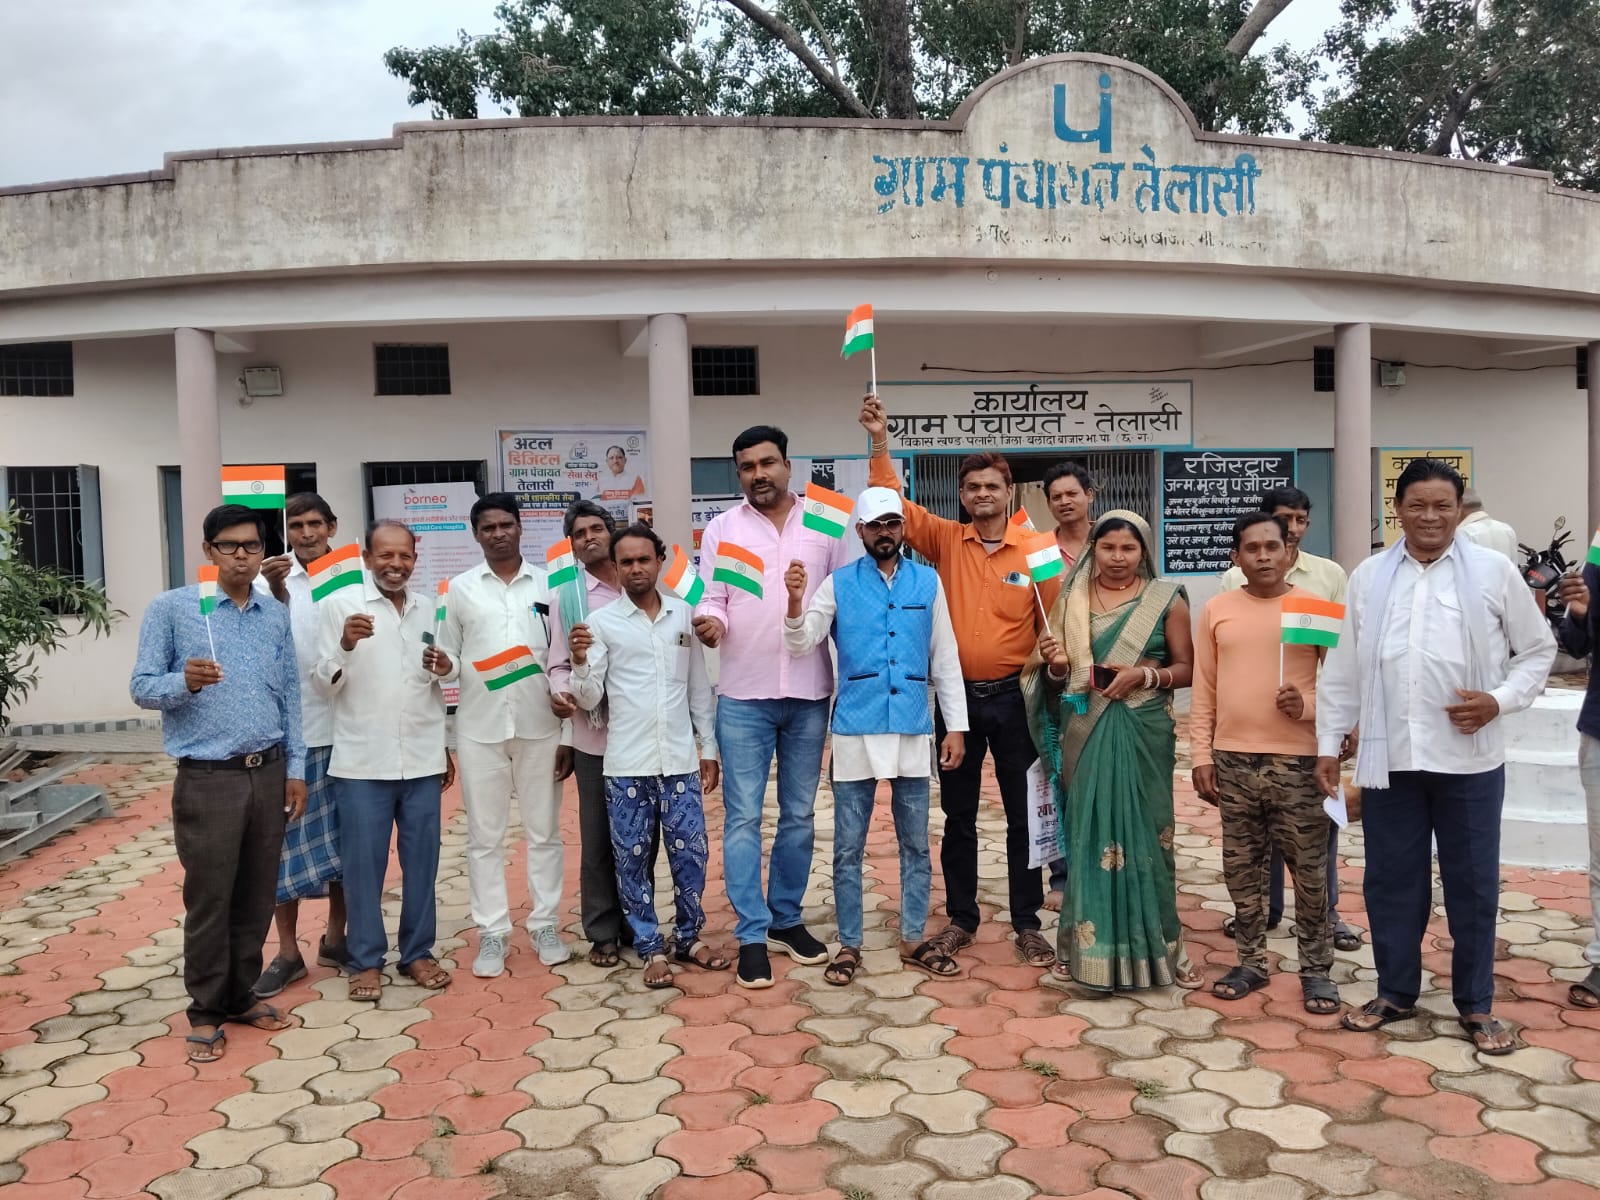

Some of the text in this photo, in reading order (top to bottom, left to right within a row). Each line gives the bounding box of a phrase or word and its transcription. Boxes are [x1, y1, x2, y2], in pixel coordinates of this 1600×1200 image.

[873, 142, 1262, 217] ग्राम पंचायत तेलासी
[974, 384, 1088, 412] कार्यालय
[886, 414, 947, 438] ग्राम
[953, 410, 1066, 434] पंचायत
[1094, 403, 1183, 432] तेलासी
[514, 438, 553, 450] अटल
[899, 435, 933, 447] विकास
[508, 451, 561, 465] डिजिटल
[509, 467, 561, 478] ग्राम पंचायत
[517, 478, 554, 490] तेलासी
[1230, 474, 1290, 492] पंजीयन
[404, 493, 447, 504] borneo
